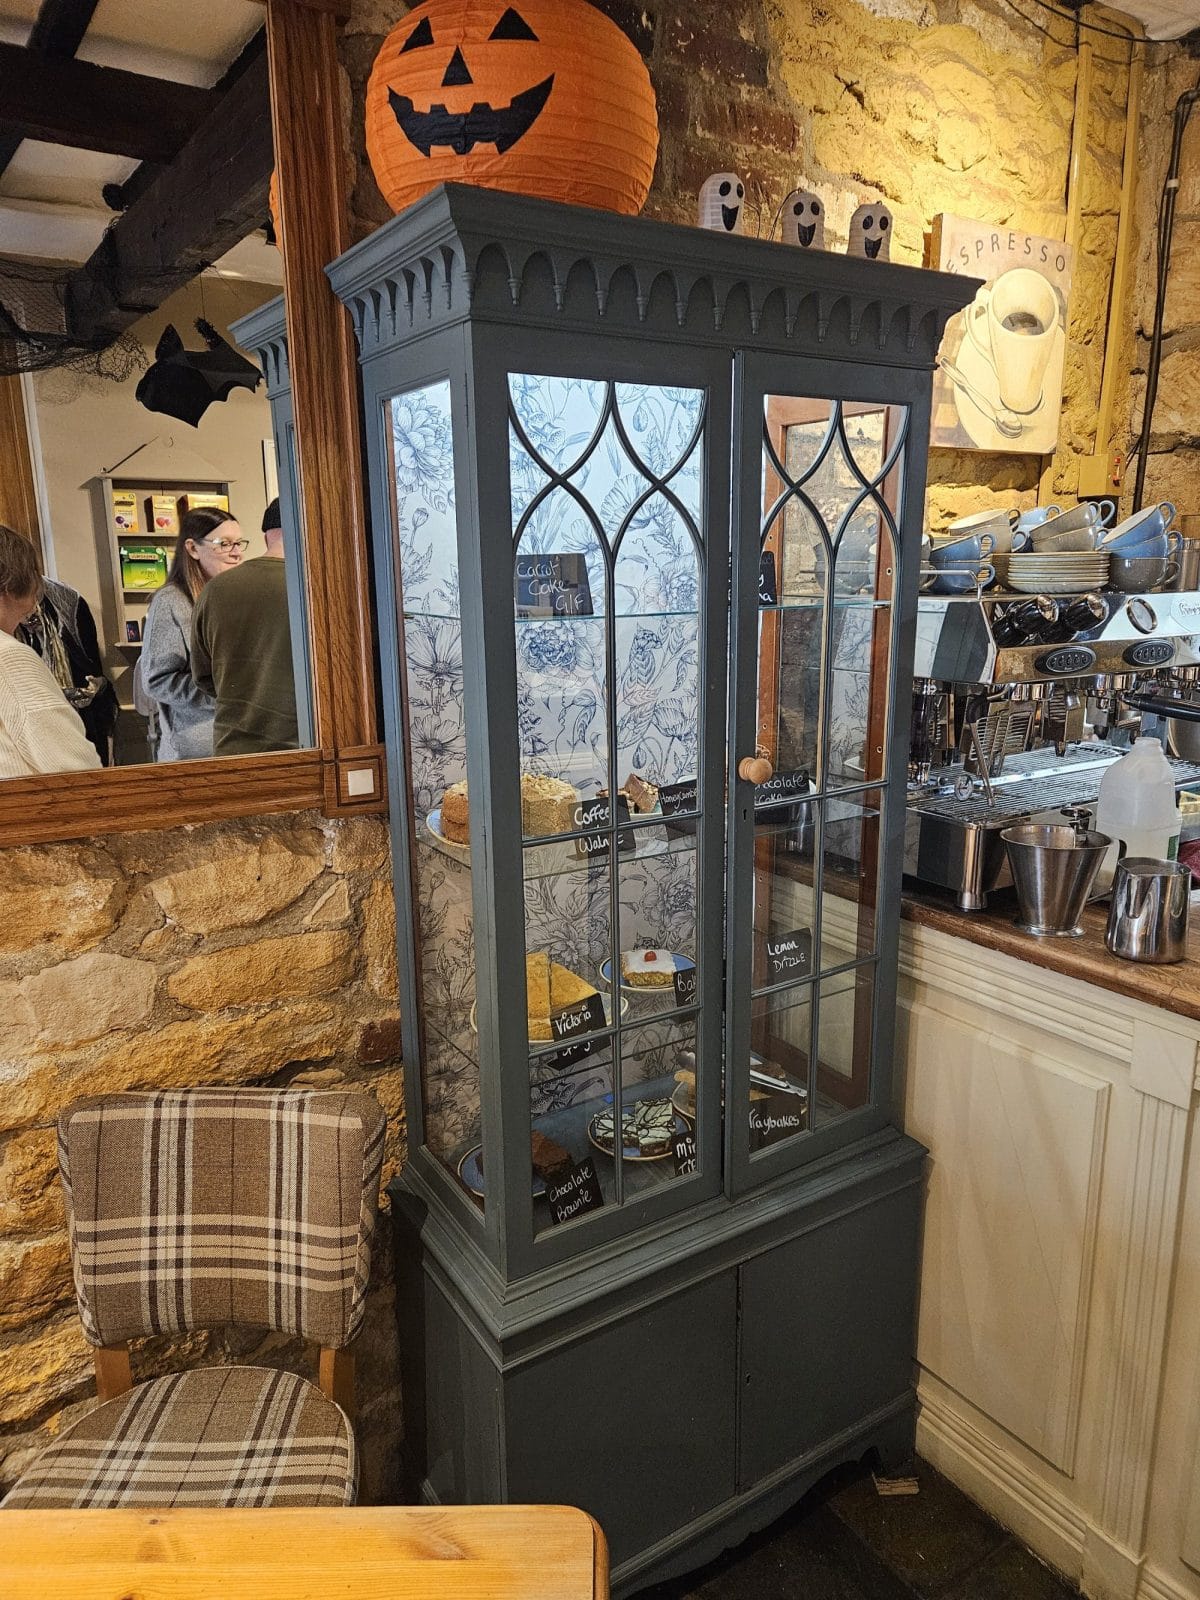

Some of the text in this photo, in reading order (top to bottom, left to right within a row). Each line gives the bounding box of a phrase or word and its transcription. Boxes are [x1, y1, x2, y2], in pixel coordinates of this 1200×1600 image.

[946, 232, 1066, 274] ESPRESSO
[516, 560, 561, 577] Carrot
[528, 579, 570, 596] Cake
[574, 803, 610, 826] Coffee
[767, 940, 800, 956] Lemon
[554, 1005, 592, 1035] Victoria
[549, 1166, 593, 1203] Chocolate
[557, 1189, 593, 1222] Brownie
